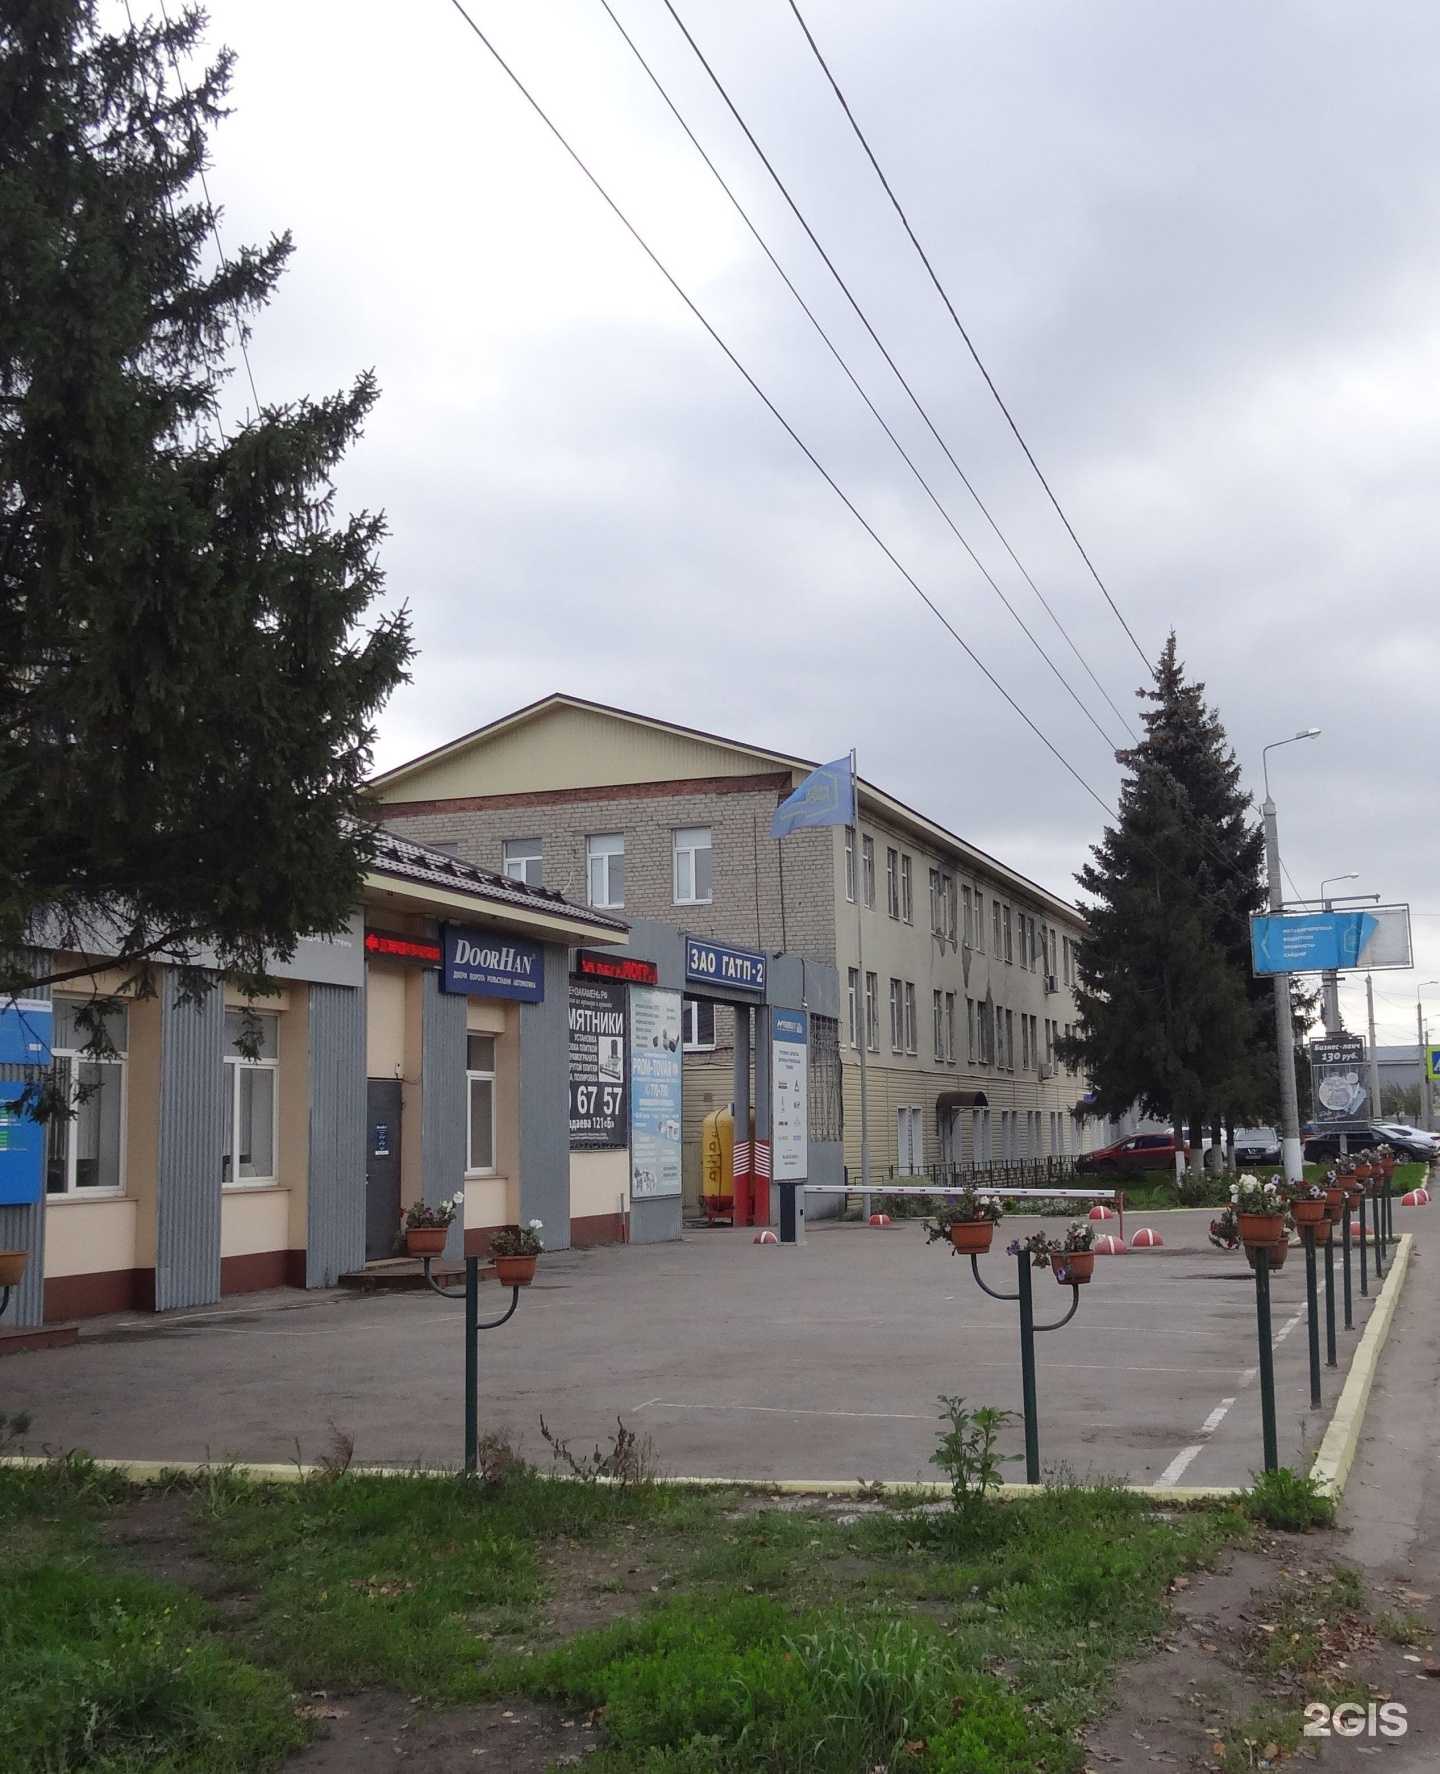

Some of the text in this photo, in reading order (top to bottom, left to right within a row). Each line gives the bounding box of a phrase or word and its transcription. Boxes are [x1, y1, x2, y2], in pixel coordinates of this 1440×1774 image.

[691, 949, 763, 983] ЗАО ГАТП-2
[1321, 1052, 1341, 1062] 130
[577, 1085, 598, 1114] 67
[603, 1086, 623, 1115] 57
